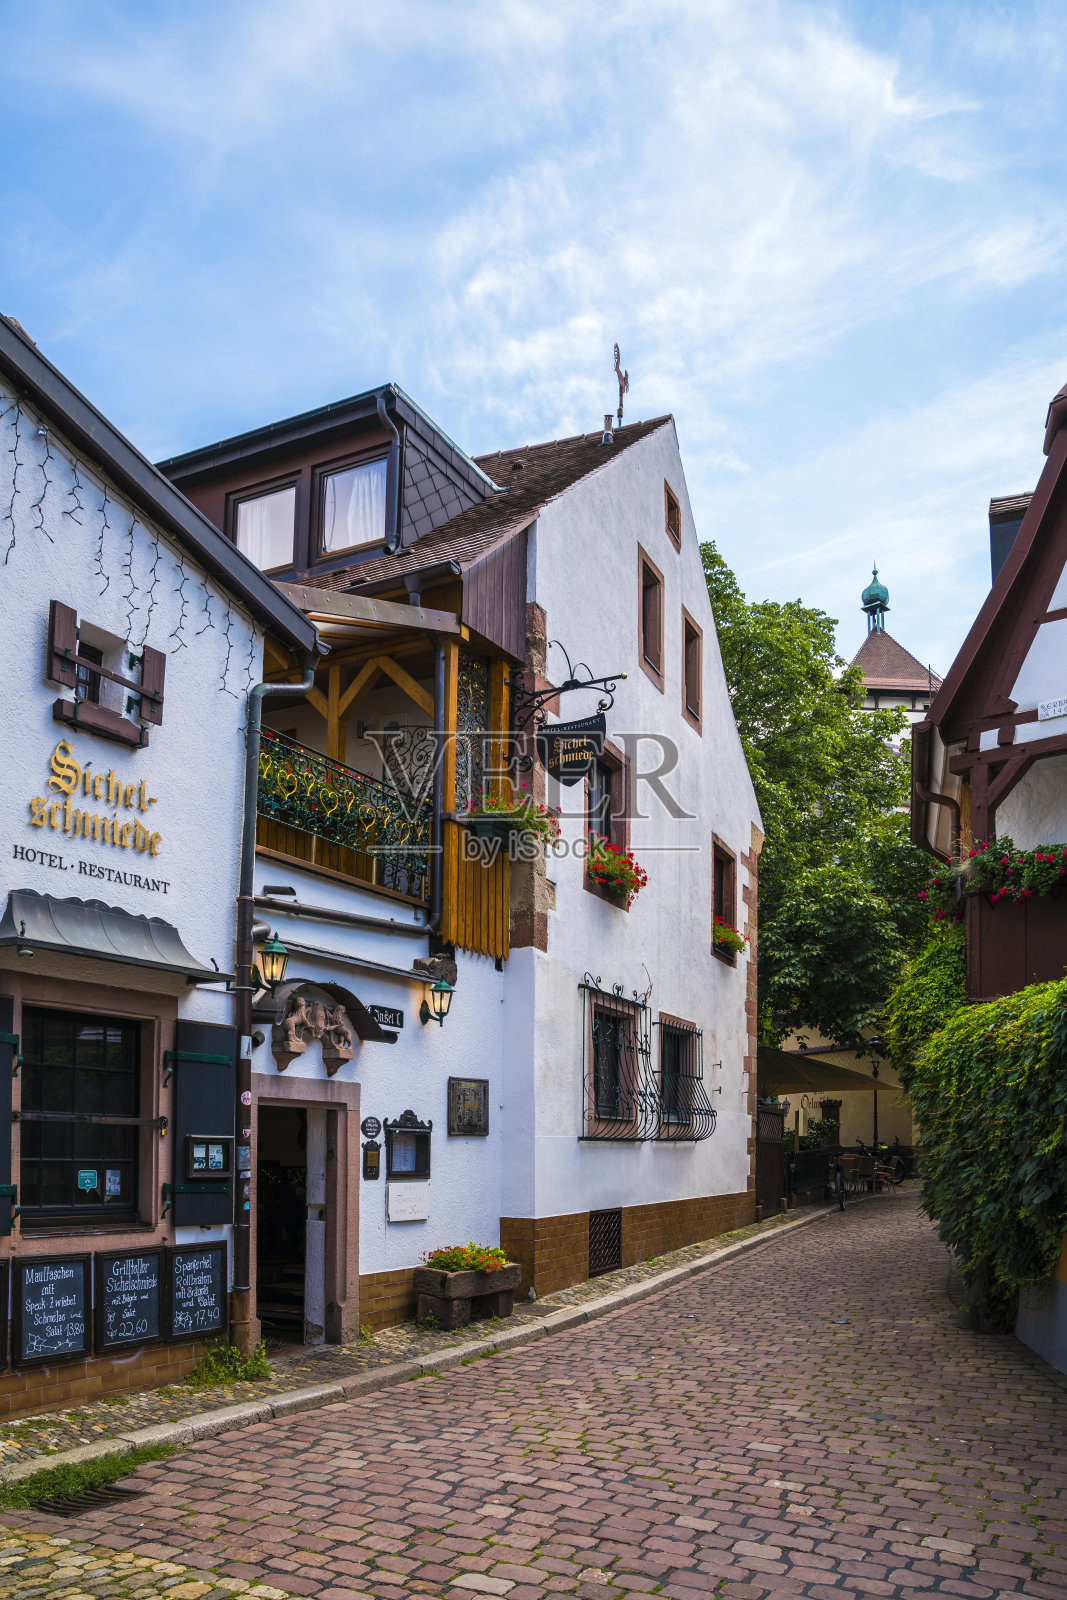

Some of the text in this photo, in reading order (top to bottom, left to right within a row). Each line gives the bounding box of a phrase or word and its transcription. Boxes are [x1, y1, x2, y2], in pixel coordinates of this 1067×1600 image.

[29, 795, 163, 857] schmiede
[12, 844, 171, 894] HOTEL RESTAURANT
[112, 1258, 150, 1276] Grillteller
[174, 1254, 213, 1276] Spanferkel
[25, 1266, 74, 1285] Maultaschen
[106, 1273, 158, 1293] Sichelschmiede
[175, 1272, 213, 1288] Rollbraten
[41, 1283, 55, 1296] mit
[182, 1293, 216, 1308] und Salat
[70, 1311, 83, 1319] und
[122, 1308, 136, 1319] Salat
[194, 1306, 220, 1326] 17,40
[45, 1322, 85, 1338] Salat 13,80
[118, 1318, 148, 1337] 22,60
